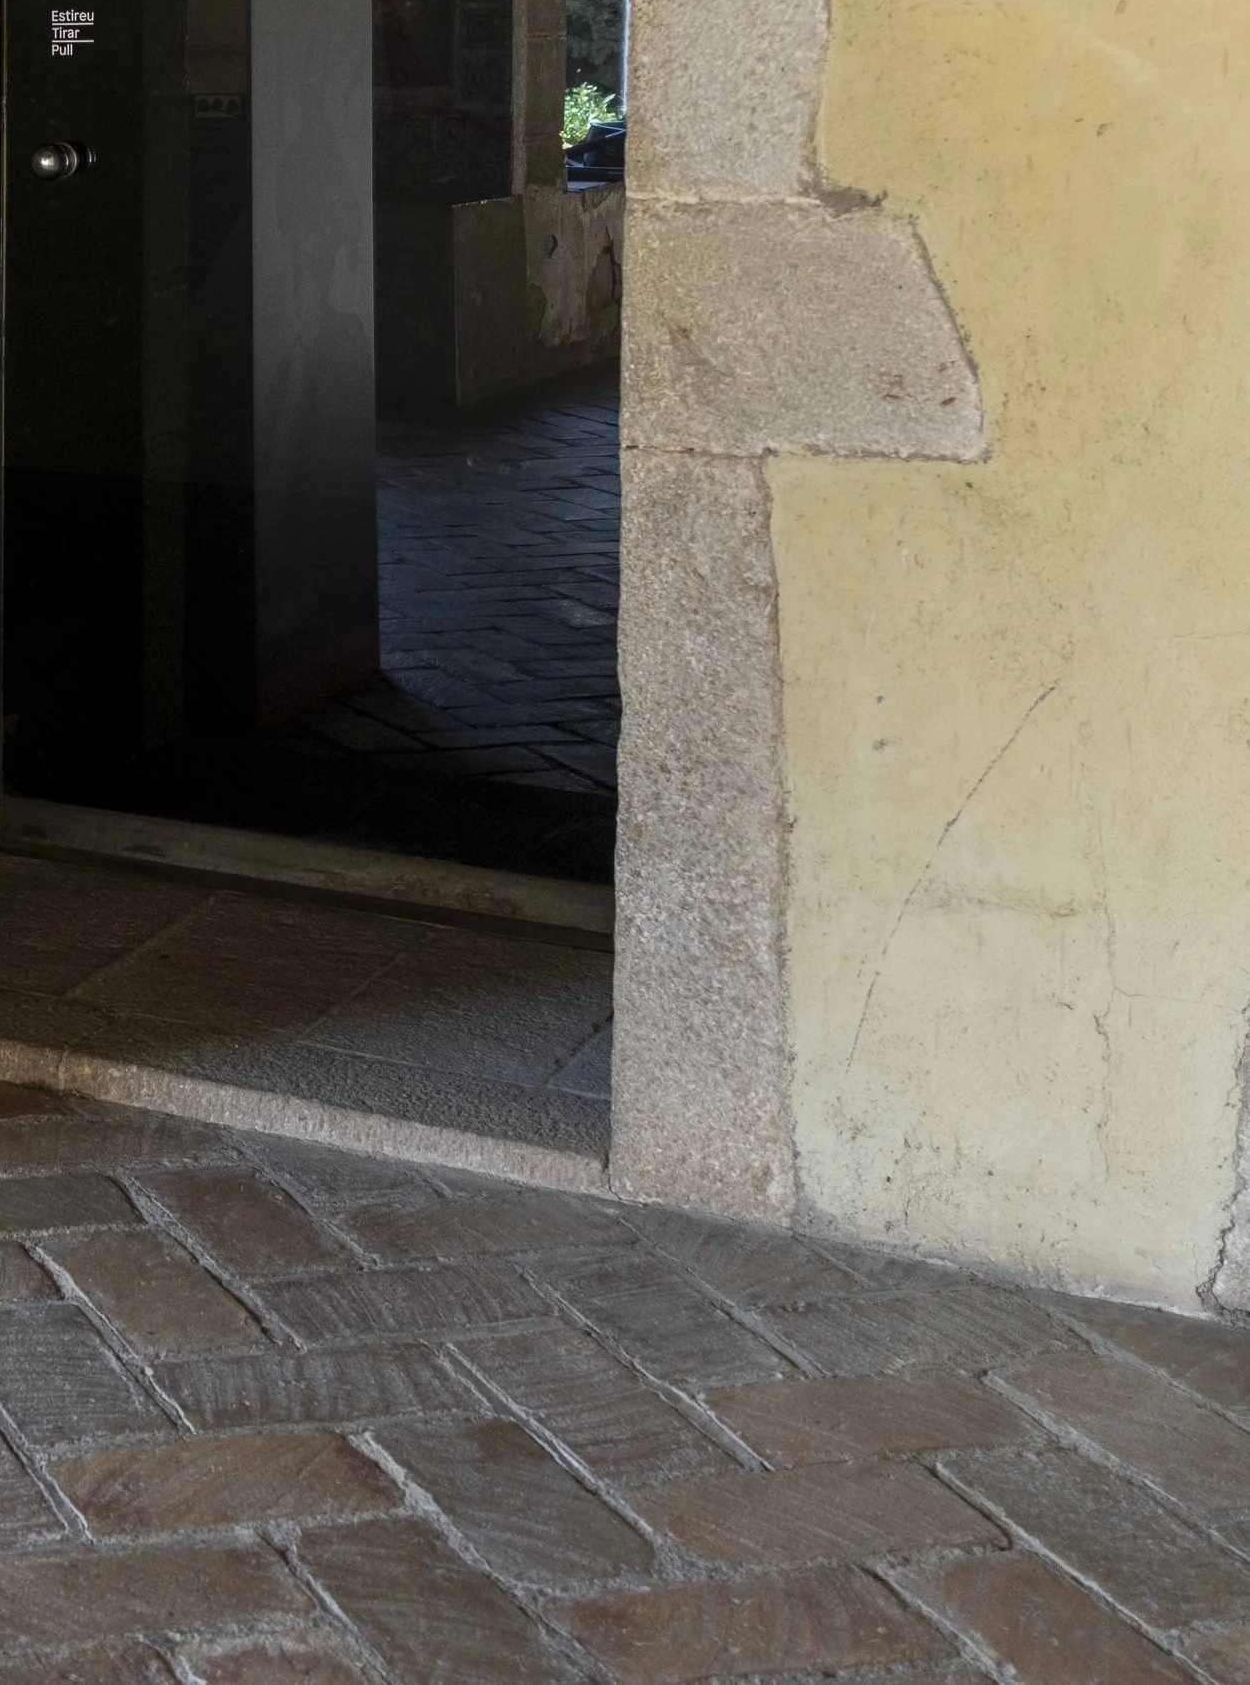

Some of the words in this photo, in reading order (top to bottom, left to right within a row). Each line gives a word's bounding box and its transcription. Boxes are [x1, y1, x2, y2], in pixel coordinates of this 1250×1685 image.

[51, 9, 95, 22] Estireu
[51, 26, 80, 39] Tirar
[51, 43, 73, 56] Pull
